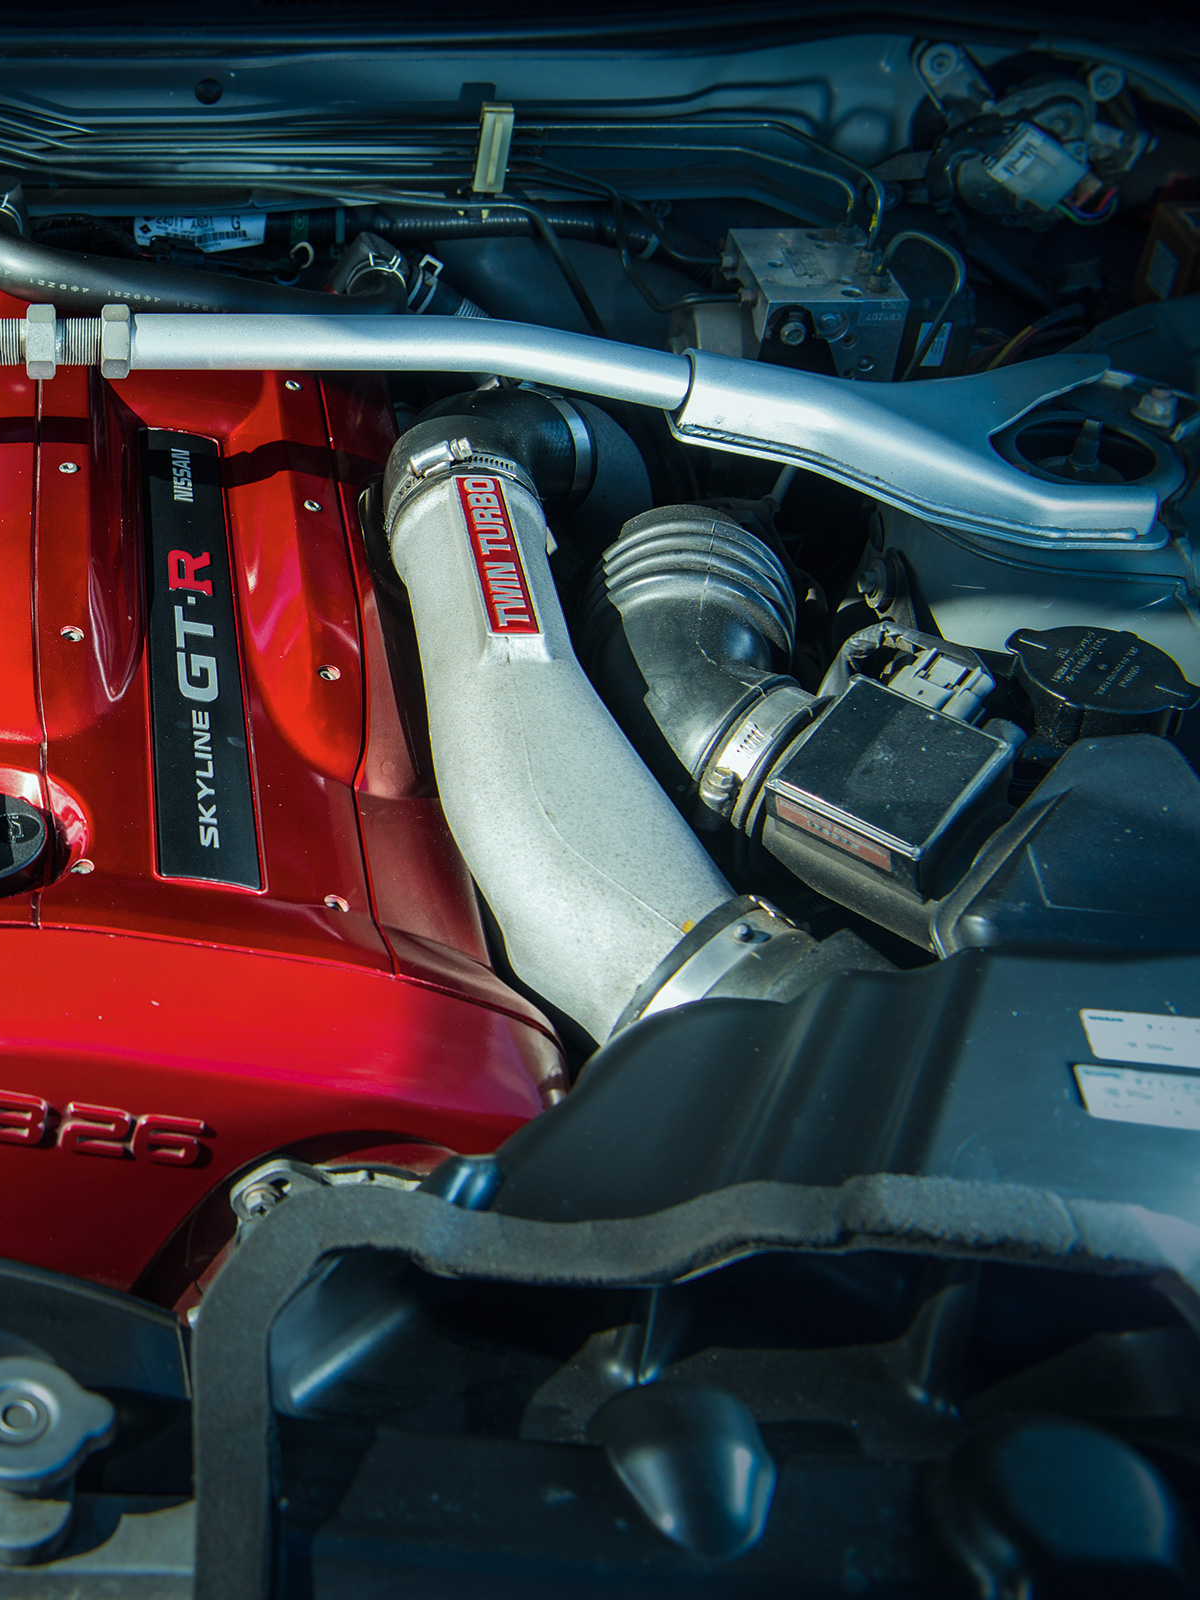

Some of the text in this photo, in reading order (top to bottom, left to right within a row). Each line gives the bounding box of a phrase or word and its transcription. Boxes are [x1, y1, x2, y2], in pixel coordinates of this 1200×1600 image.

[171, 448, 194, 502] NISSAN
[464, 477, 530, 627] TWIN TURBO
[191, 709, 221, 849] SKYLINE
